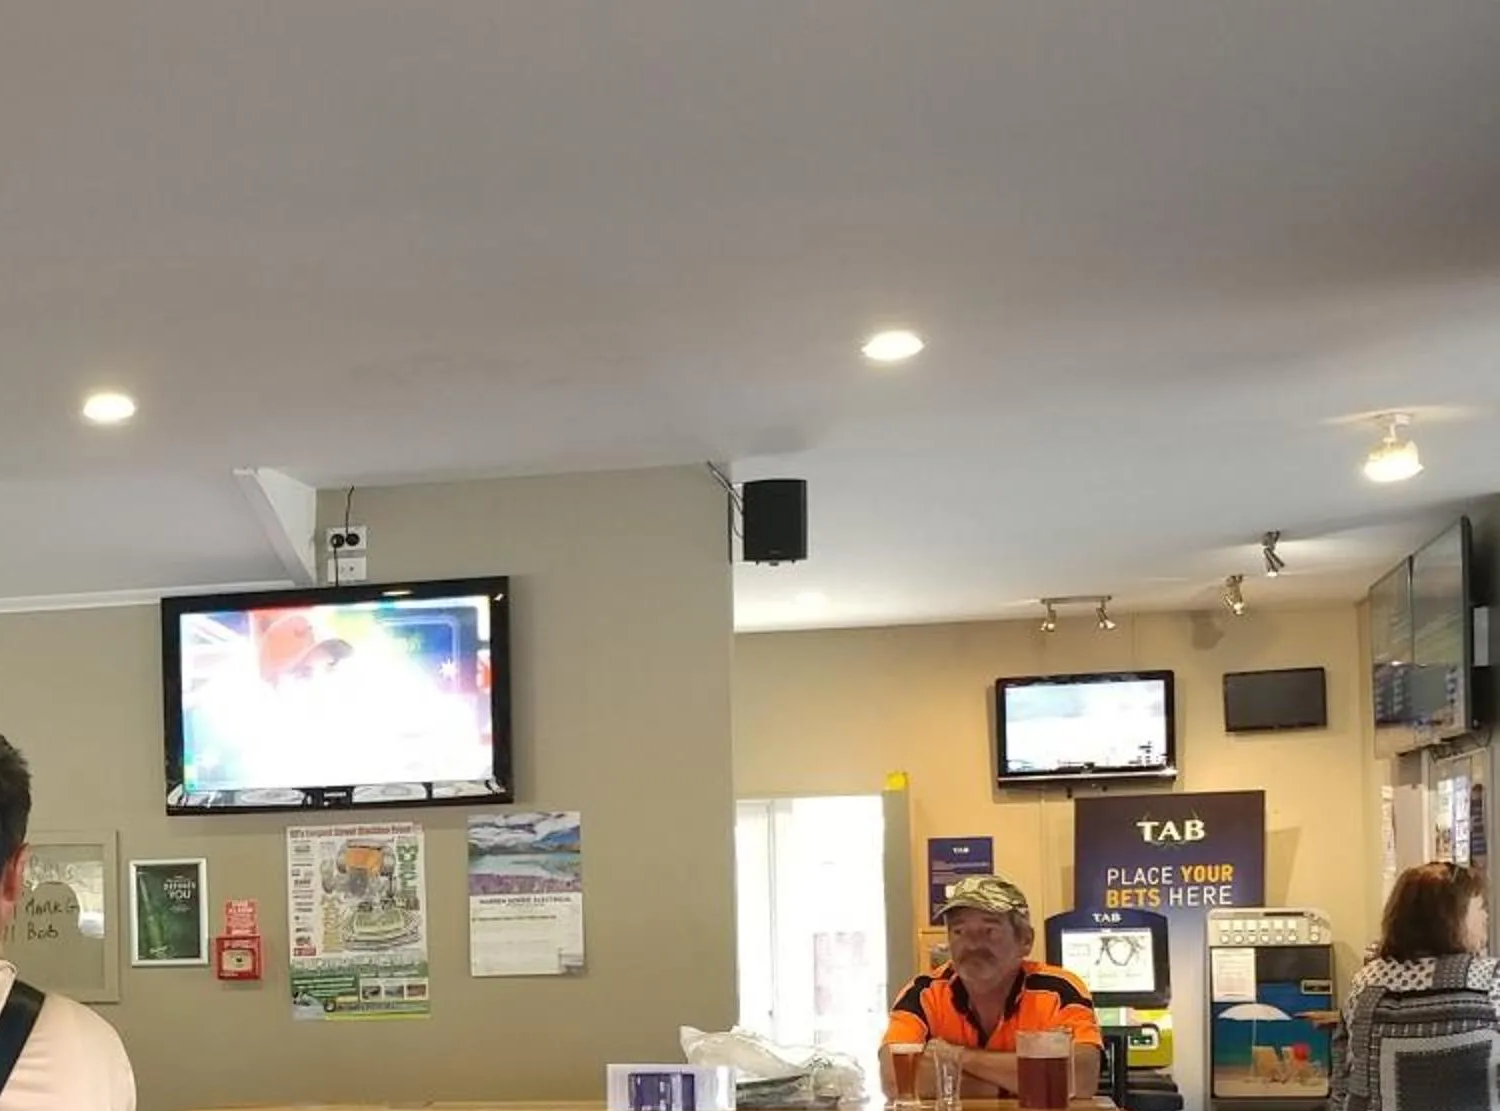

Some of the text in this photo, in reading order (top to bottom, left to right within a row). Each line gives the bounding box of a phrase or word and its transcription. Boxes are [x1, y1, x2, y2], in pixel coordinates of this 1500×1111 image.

[1136, 819, 1206, 842] TAB
[1107, 863, 1234, 886] PLACE YOUR
[1105, 885, 1233, 909] BETS HERE
[1092, 911, 1122, 923] TAB
